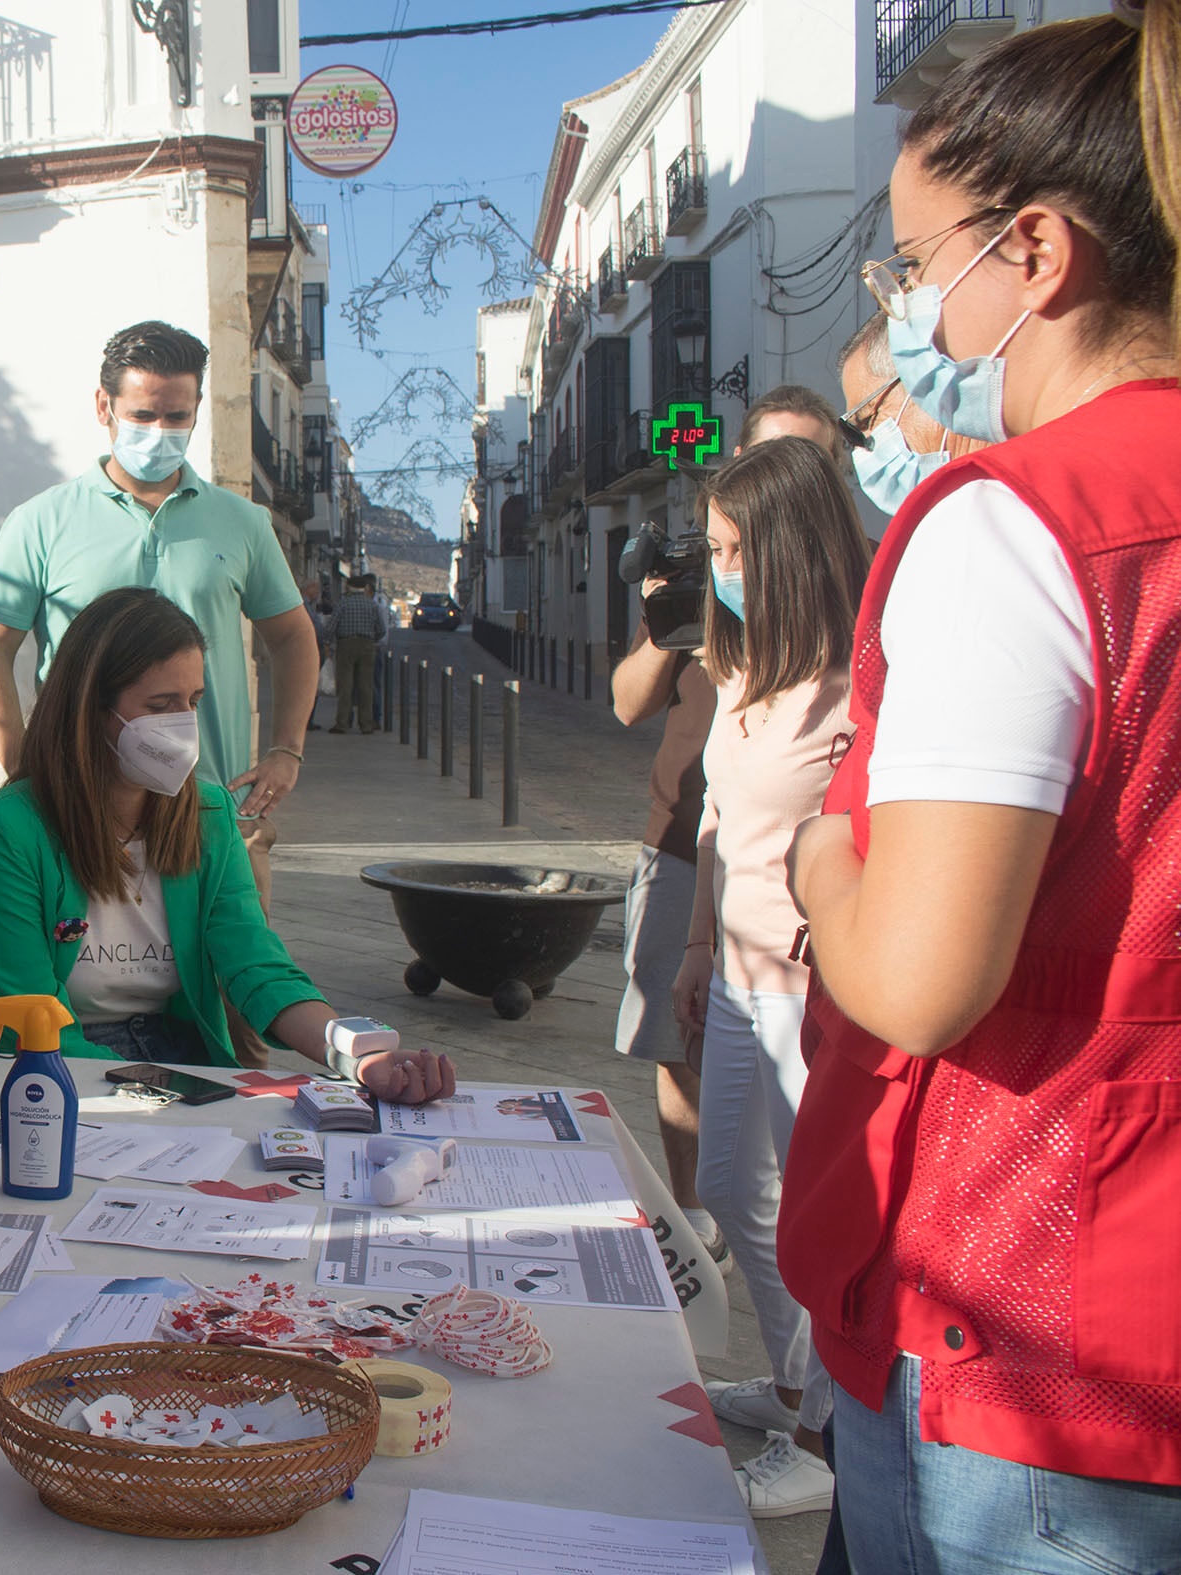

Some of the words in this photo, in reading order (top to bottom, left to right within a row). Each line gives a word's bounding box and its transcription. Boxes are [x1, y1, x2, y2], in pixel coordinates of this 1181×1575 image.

[297, 104, 391, 134] golositos
[20, 1105, 50, 1113] SOLUCIÓN
[10, 1111, 62, 1120] HIDROALCOHÓLICA
